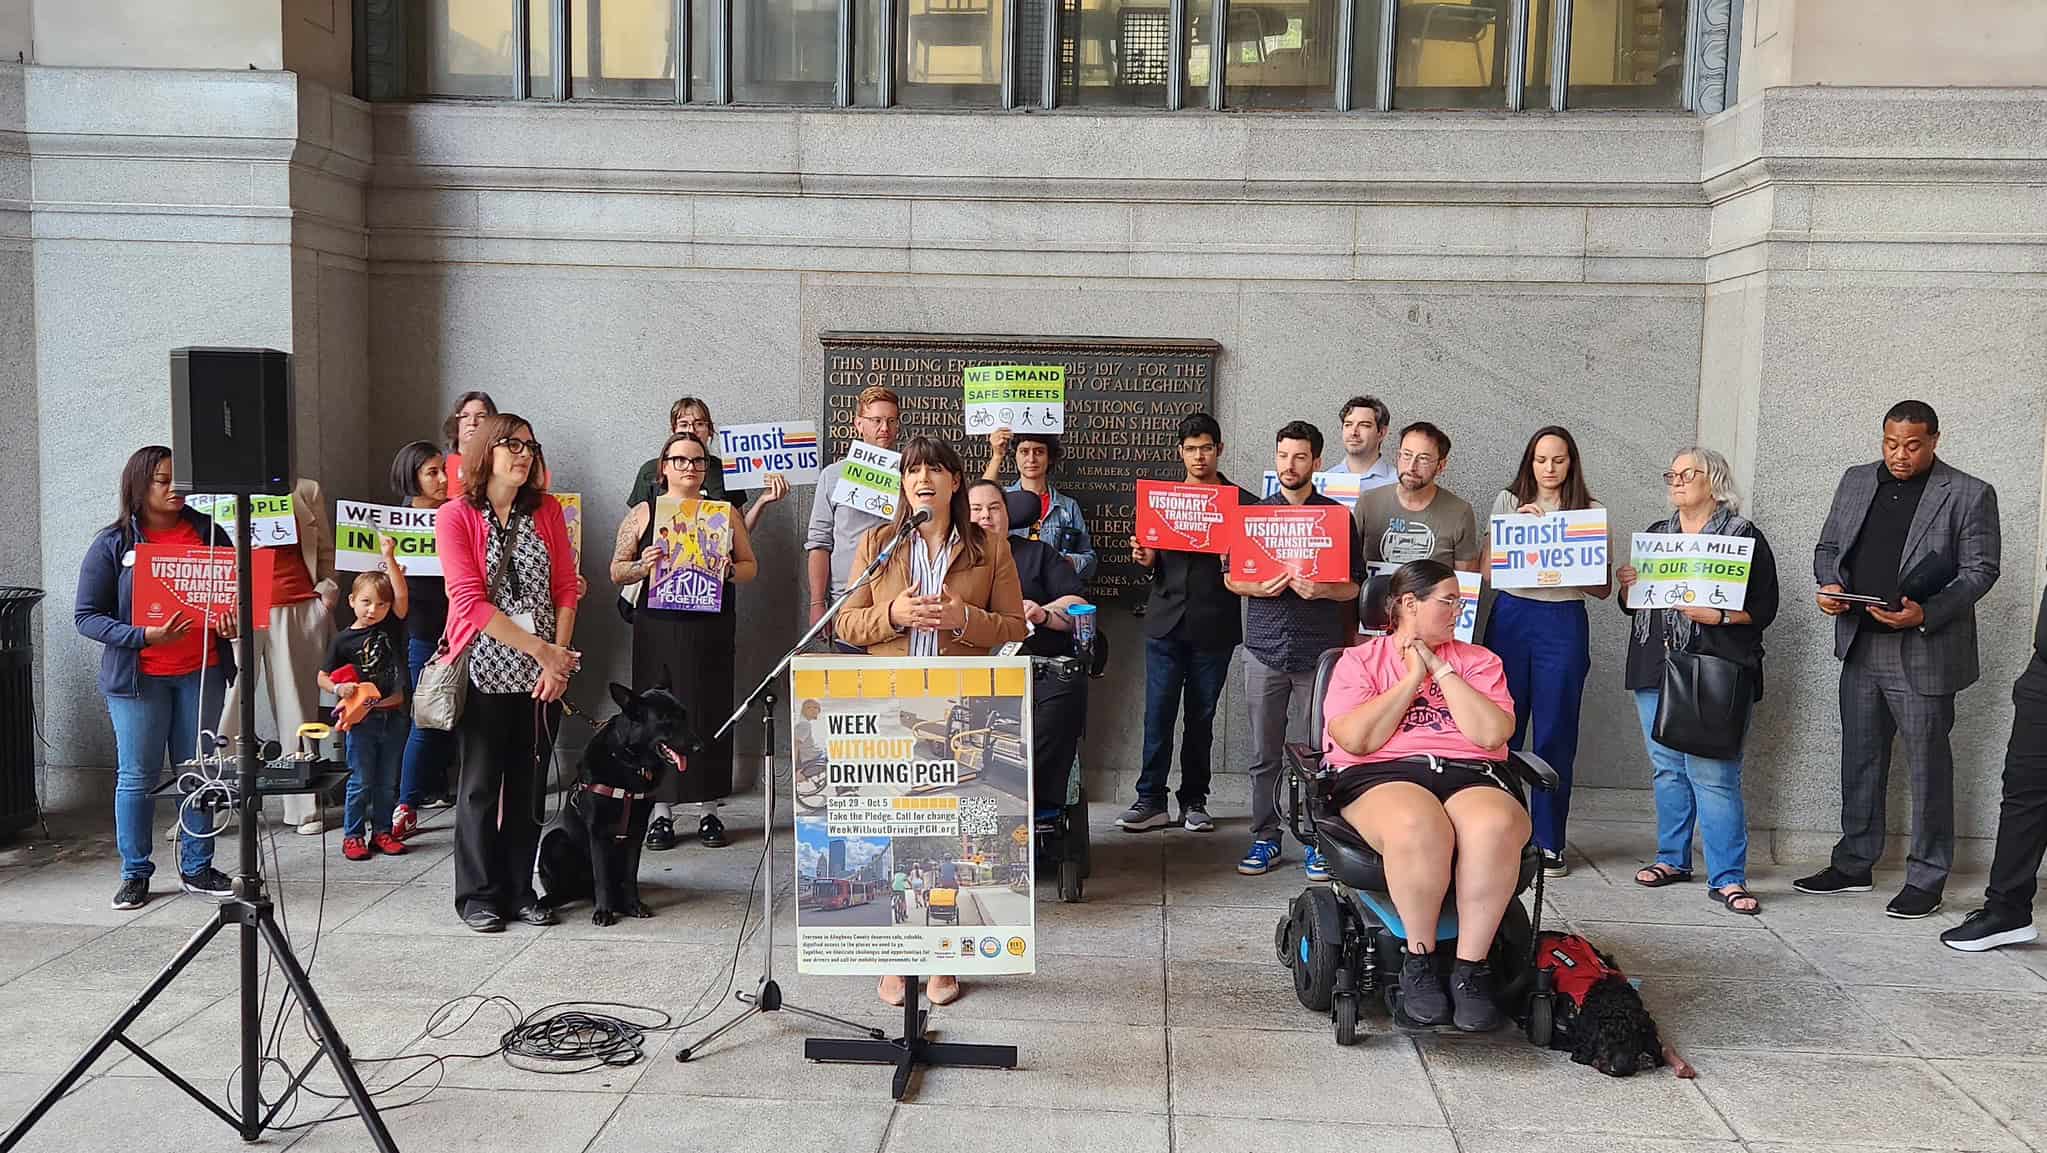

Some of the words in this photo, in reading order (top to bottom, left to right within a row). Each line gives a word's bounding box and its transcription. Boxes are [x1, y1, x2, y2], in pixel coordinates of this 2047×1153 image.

[830, 356, 864, 371] THIS
[871, 357, 942, 372] BUILDING
[1137, 363, 1168, 377] FOR
[1174, 364, 1206, 378] THE
[829, 372, 865, 386] CITY
[867, 372, 888, 387] OF
[892, 373, 965, 388] PITTSBUR
[968, 371, 990, 382] WE
[995, 370, 1060, 381] DEMAND
[1091, 378, 1112, 391] OF
[829, 395, 860, 408] CIT
[968, 389, 999, 400] SAFE
[1003, 389, 1059, 399] STREETS
[1065, 400, 1149, 415] RMSTRONG,
[1151, 401, 1204, 416] MAYOR
[899, 411, 965, 426] OEHRIN
[1087, 416, 1126, 429] JOHN
[720, 427, 785, 453] Transit
[830, 426, 864, 439] ROB
[1059, 431, 1128, 445] CHARLES
[799, 451, 817, 469] us
[853, 447, 888, 466] BIKE
[847, 466, 862, 479] IN
[865, 471, 893, 488] OUR
[1077, 466, 1130, 478] MEMBERS
[221, 499, 289, 521] PPLE
[1149, 495, 1209, 512] VISIONARY
[346, 505, 382, 524] WE
[390, 511, 436, 528] BIKE
[1165, 509, 1202, 521] TRANSIT
[1173, 520, 1208, 532] SERVICE
[1245, 522, 1314, 537] VISIONARY
[1492, 516, 1568, 545] Transit
[348, 531, 374, 549] IN
[1264, 537, 1310, 549] TRANSIT
[1276, 548, 1315, 560] SERVICE
[1636, 540, 1684, 553] WALK
[1689, 541, 1700, 553] A
[1707, 542, 1749, 556] MILE
[1102, 554, 1136, 563] COUN
[1581, 546, 1605, 567] us
[152, 562, 233, 580] VISIONARY
[1660, 562, 1688, 574] OUR
[1693, 562, 1745, 577] SHOES
[174, 579, 225, 593] TRANSIT
[676, 571, 718, 598] RIDE
[187, 592, 232, 604] SERVICE
[659, 594, 715, 606] TOGETHER
[828, 715, 877, 735] WEEK
[829, 739, 913, 760] WITHOUT
[830, 764, 910, 784] DRIVING
[916, 763, 955, 784] PGH
[829, 798, 847, 809] Sept
[867, 799, 881, 808] Oct
[882, 799, 888, 808] 5
[829, 812, 848, 821] Take
[850, 812, 862, 821] the
[864, 812, 894, 823] Pledge.
[896, 812, 911, 821] Call
[913, 812, 924, 821] for
[829, 825, 956, 836] WeekWithoutDrivingPGH.org
